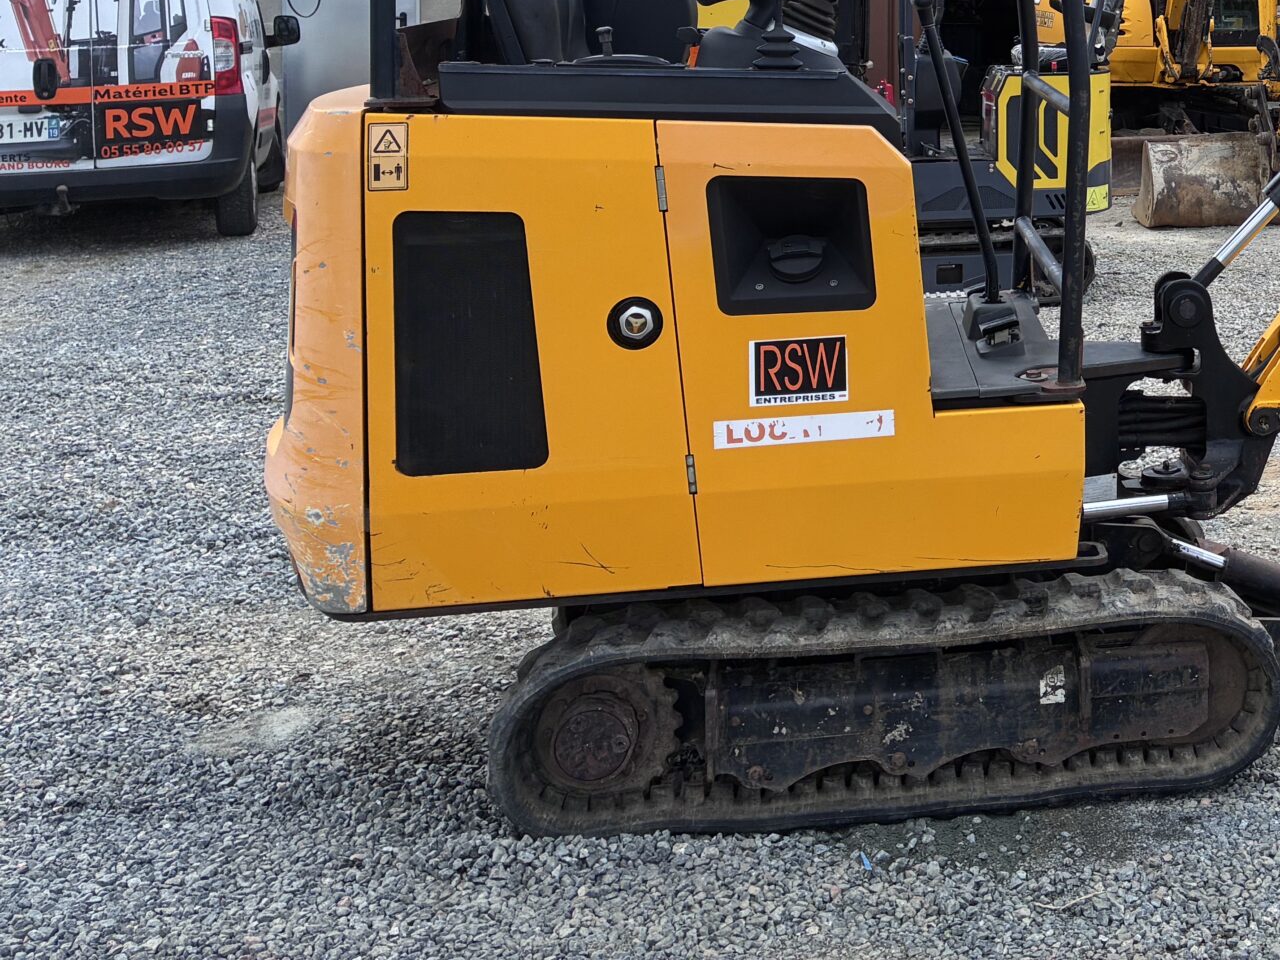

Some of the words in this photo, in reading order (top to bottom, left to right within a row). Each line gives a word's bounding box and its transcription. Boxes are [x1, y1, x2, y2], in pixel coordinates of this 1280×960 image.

[94, 85, 175, 100] Matériel
[179, 83, 215, 95] BTP
[105, 104, 197, 139] RSW
[49, 129, 58, 137] 19
[101, 145, 119, 158] 05
[123, 144, 140, 157] 55
[143, 143, 162, 155] 80
[165, 141, 184, 153] 00
[188, 140, 204, 152] 57
[27, 160, 70, 169] BOURG
[759, 341, 841, 392] RSW
[755, 393, 836, 404] ENTREPRISES
